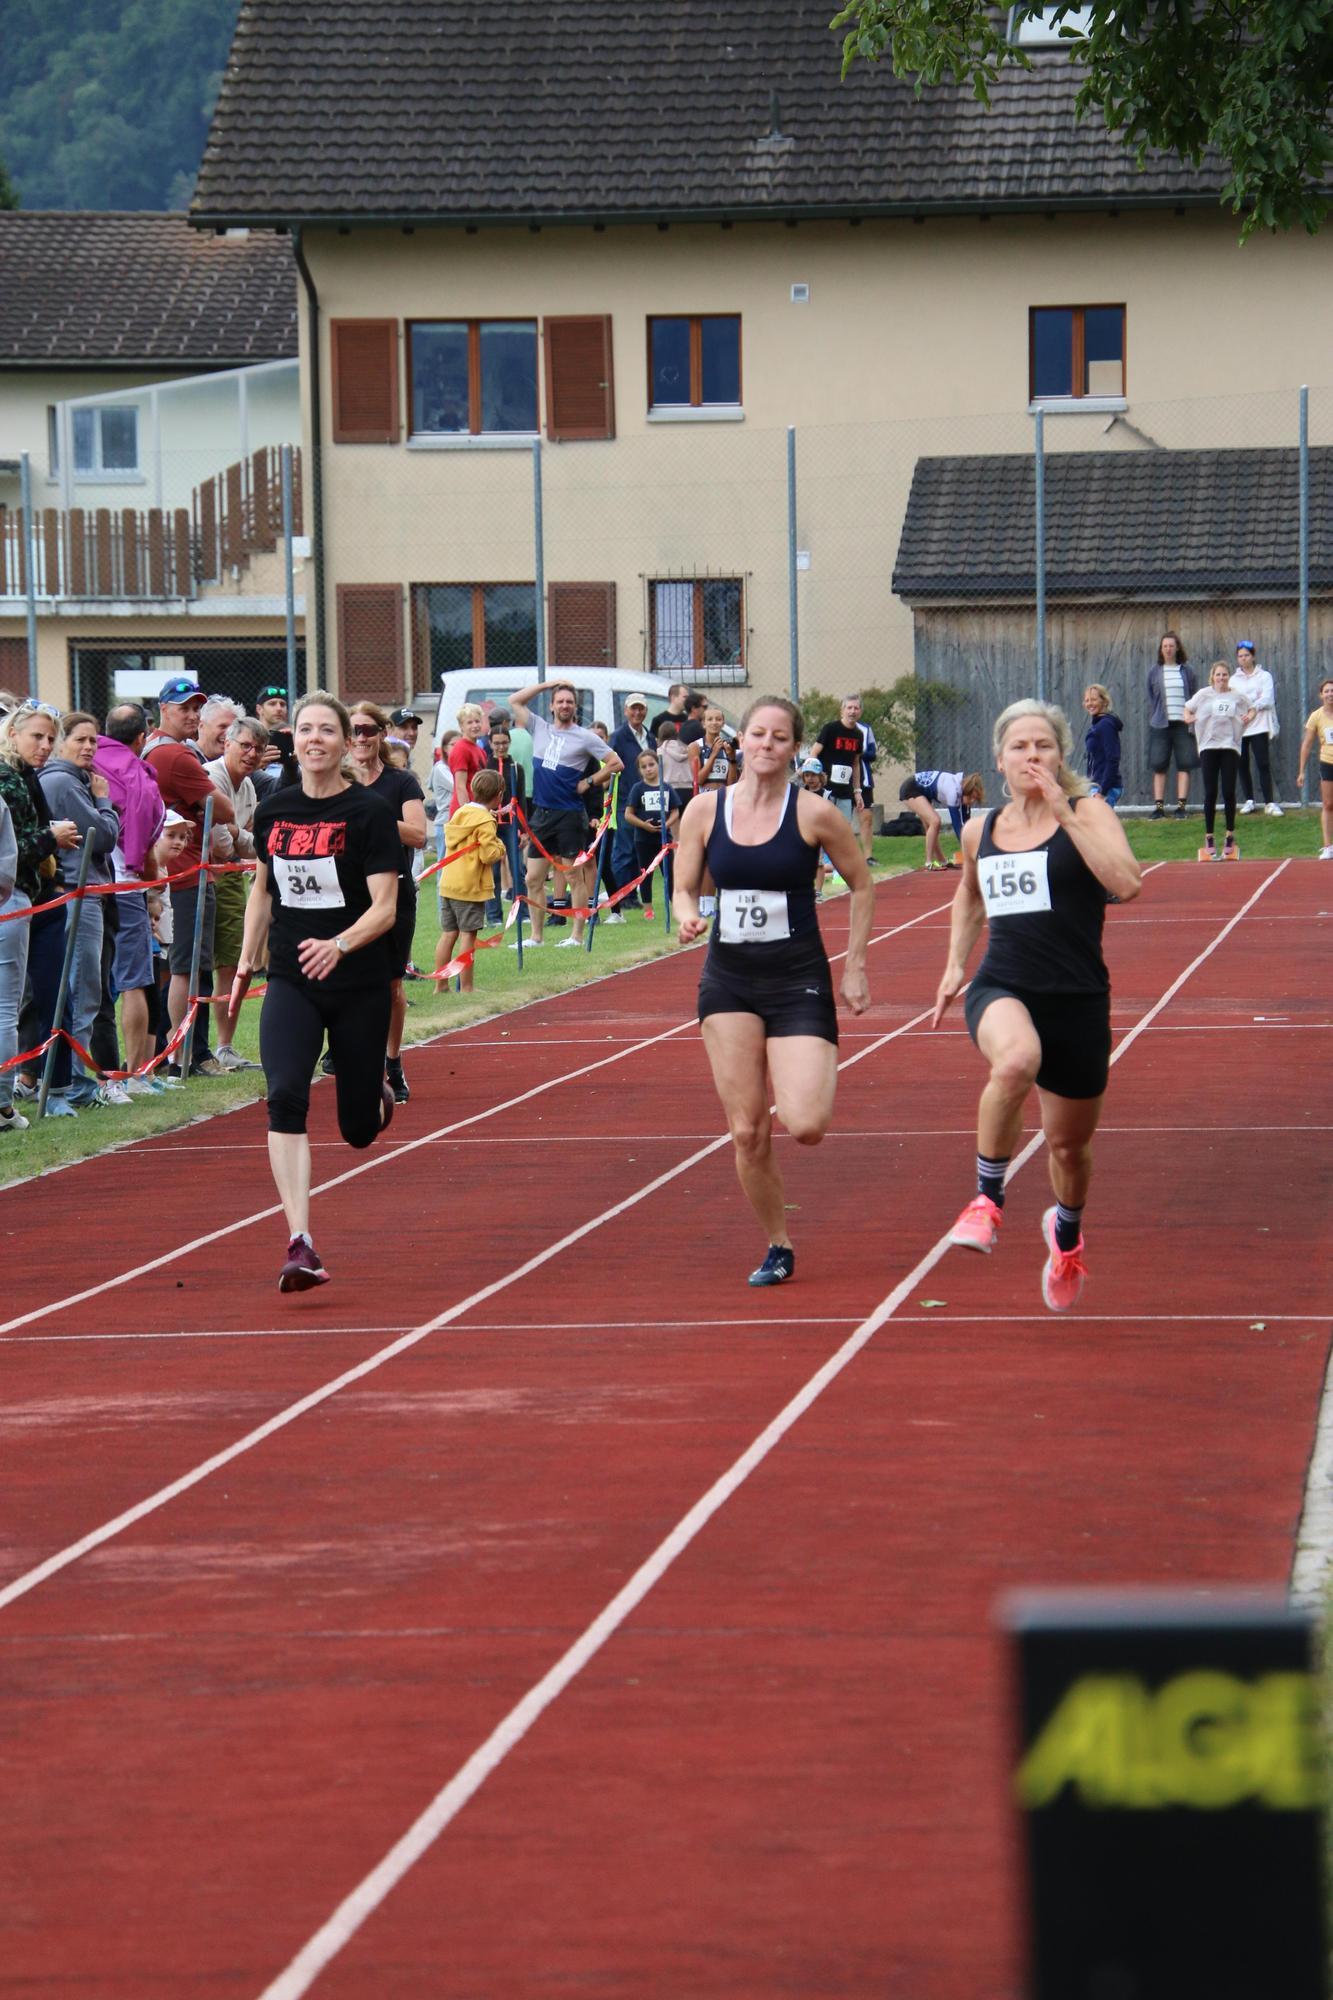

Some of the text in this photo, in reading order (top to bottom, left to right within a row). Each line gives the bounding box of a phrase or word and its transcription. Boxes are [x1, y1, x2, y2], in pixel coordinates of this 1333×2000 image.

[287, 875, 322, 895] 34
[986, 870, 1037, 899] 156
[735, 906, 768, 929] 79
